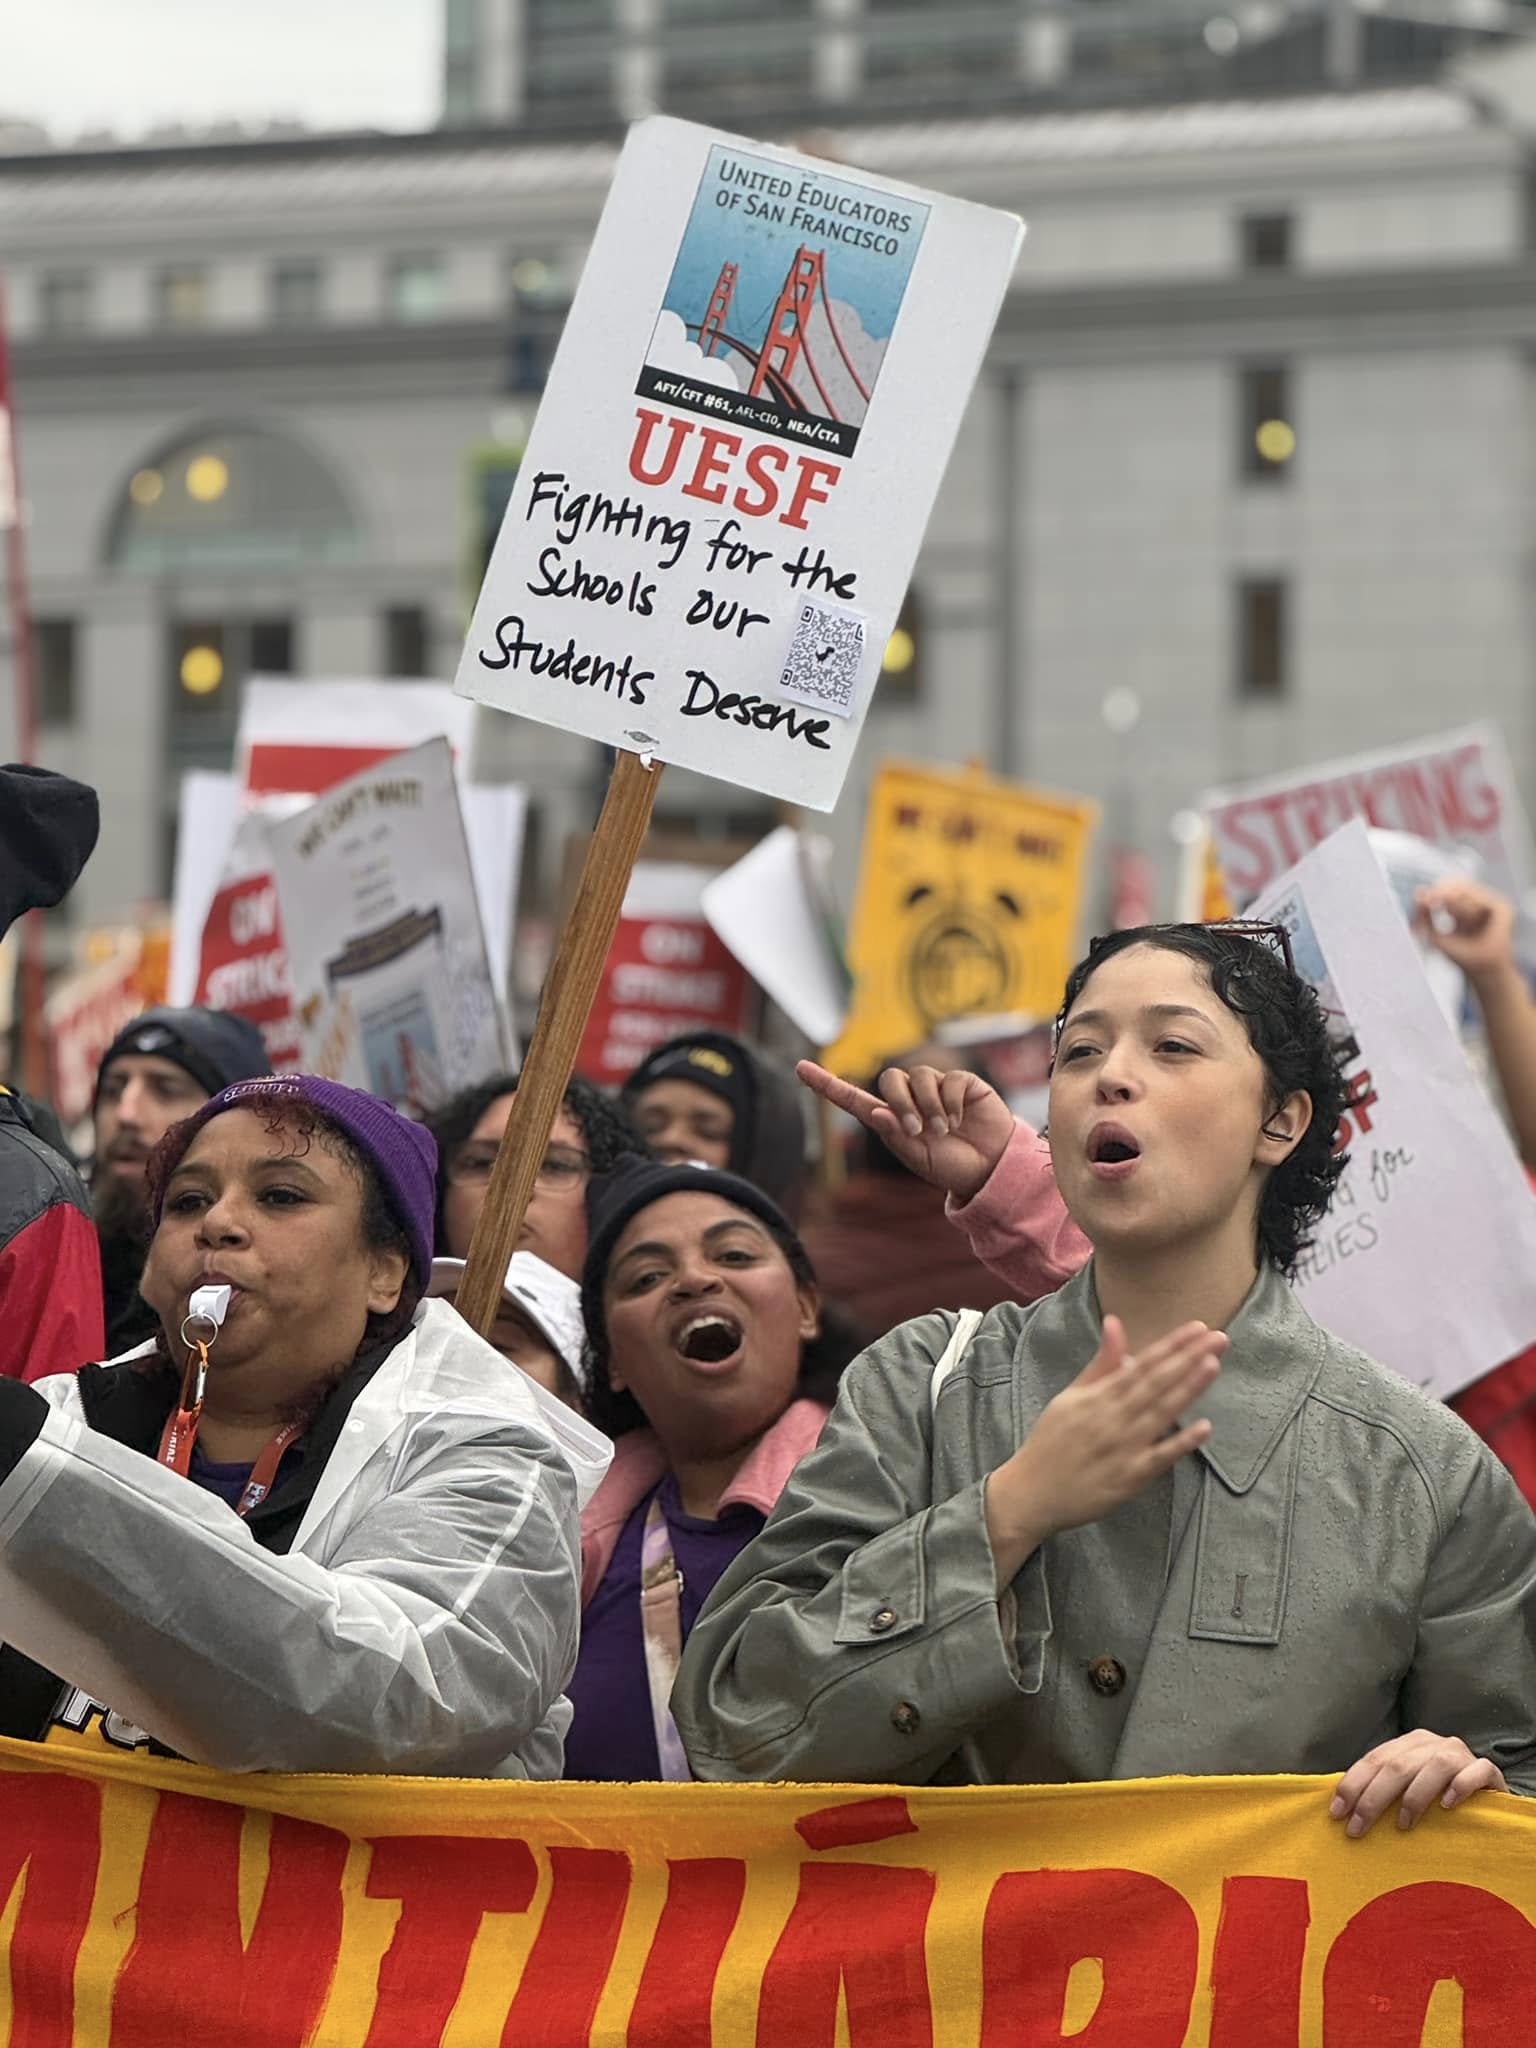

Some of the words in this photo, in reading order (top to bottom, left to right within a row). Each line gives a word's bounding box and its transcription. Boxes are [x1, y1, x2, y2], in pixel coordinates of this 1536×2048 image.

[719, 159, 792, 197] UNITED
[798, 181, 912, 234] EDUCATORS
[744, 194, 785, 222] SAN
[790, 206, 900, 257] FRANCISCO
[653, 379, 704, 405] AFT/CFT
[703, 392, 734, 416] #61,
[736, 405, 783, 429] AFL-CIO,
[787, 416, 841, 445] NEA/CTA
[628, 408, 841, 531] UESF
[525, 471, 690, 569] Fighting
[705, 519, 773, 573] for
[782, 546, 857, 600] the
[527, 547, 656, 617] Schools
[479, 616, 655, 705] Students
[679, 669, 831, 750] Deserve
